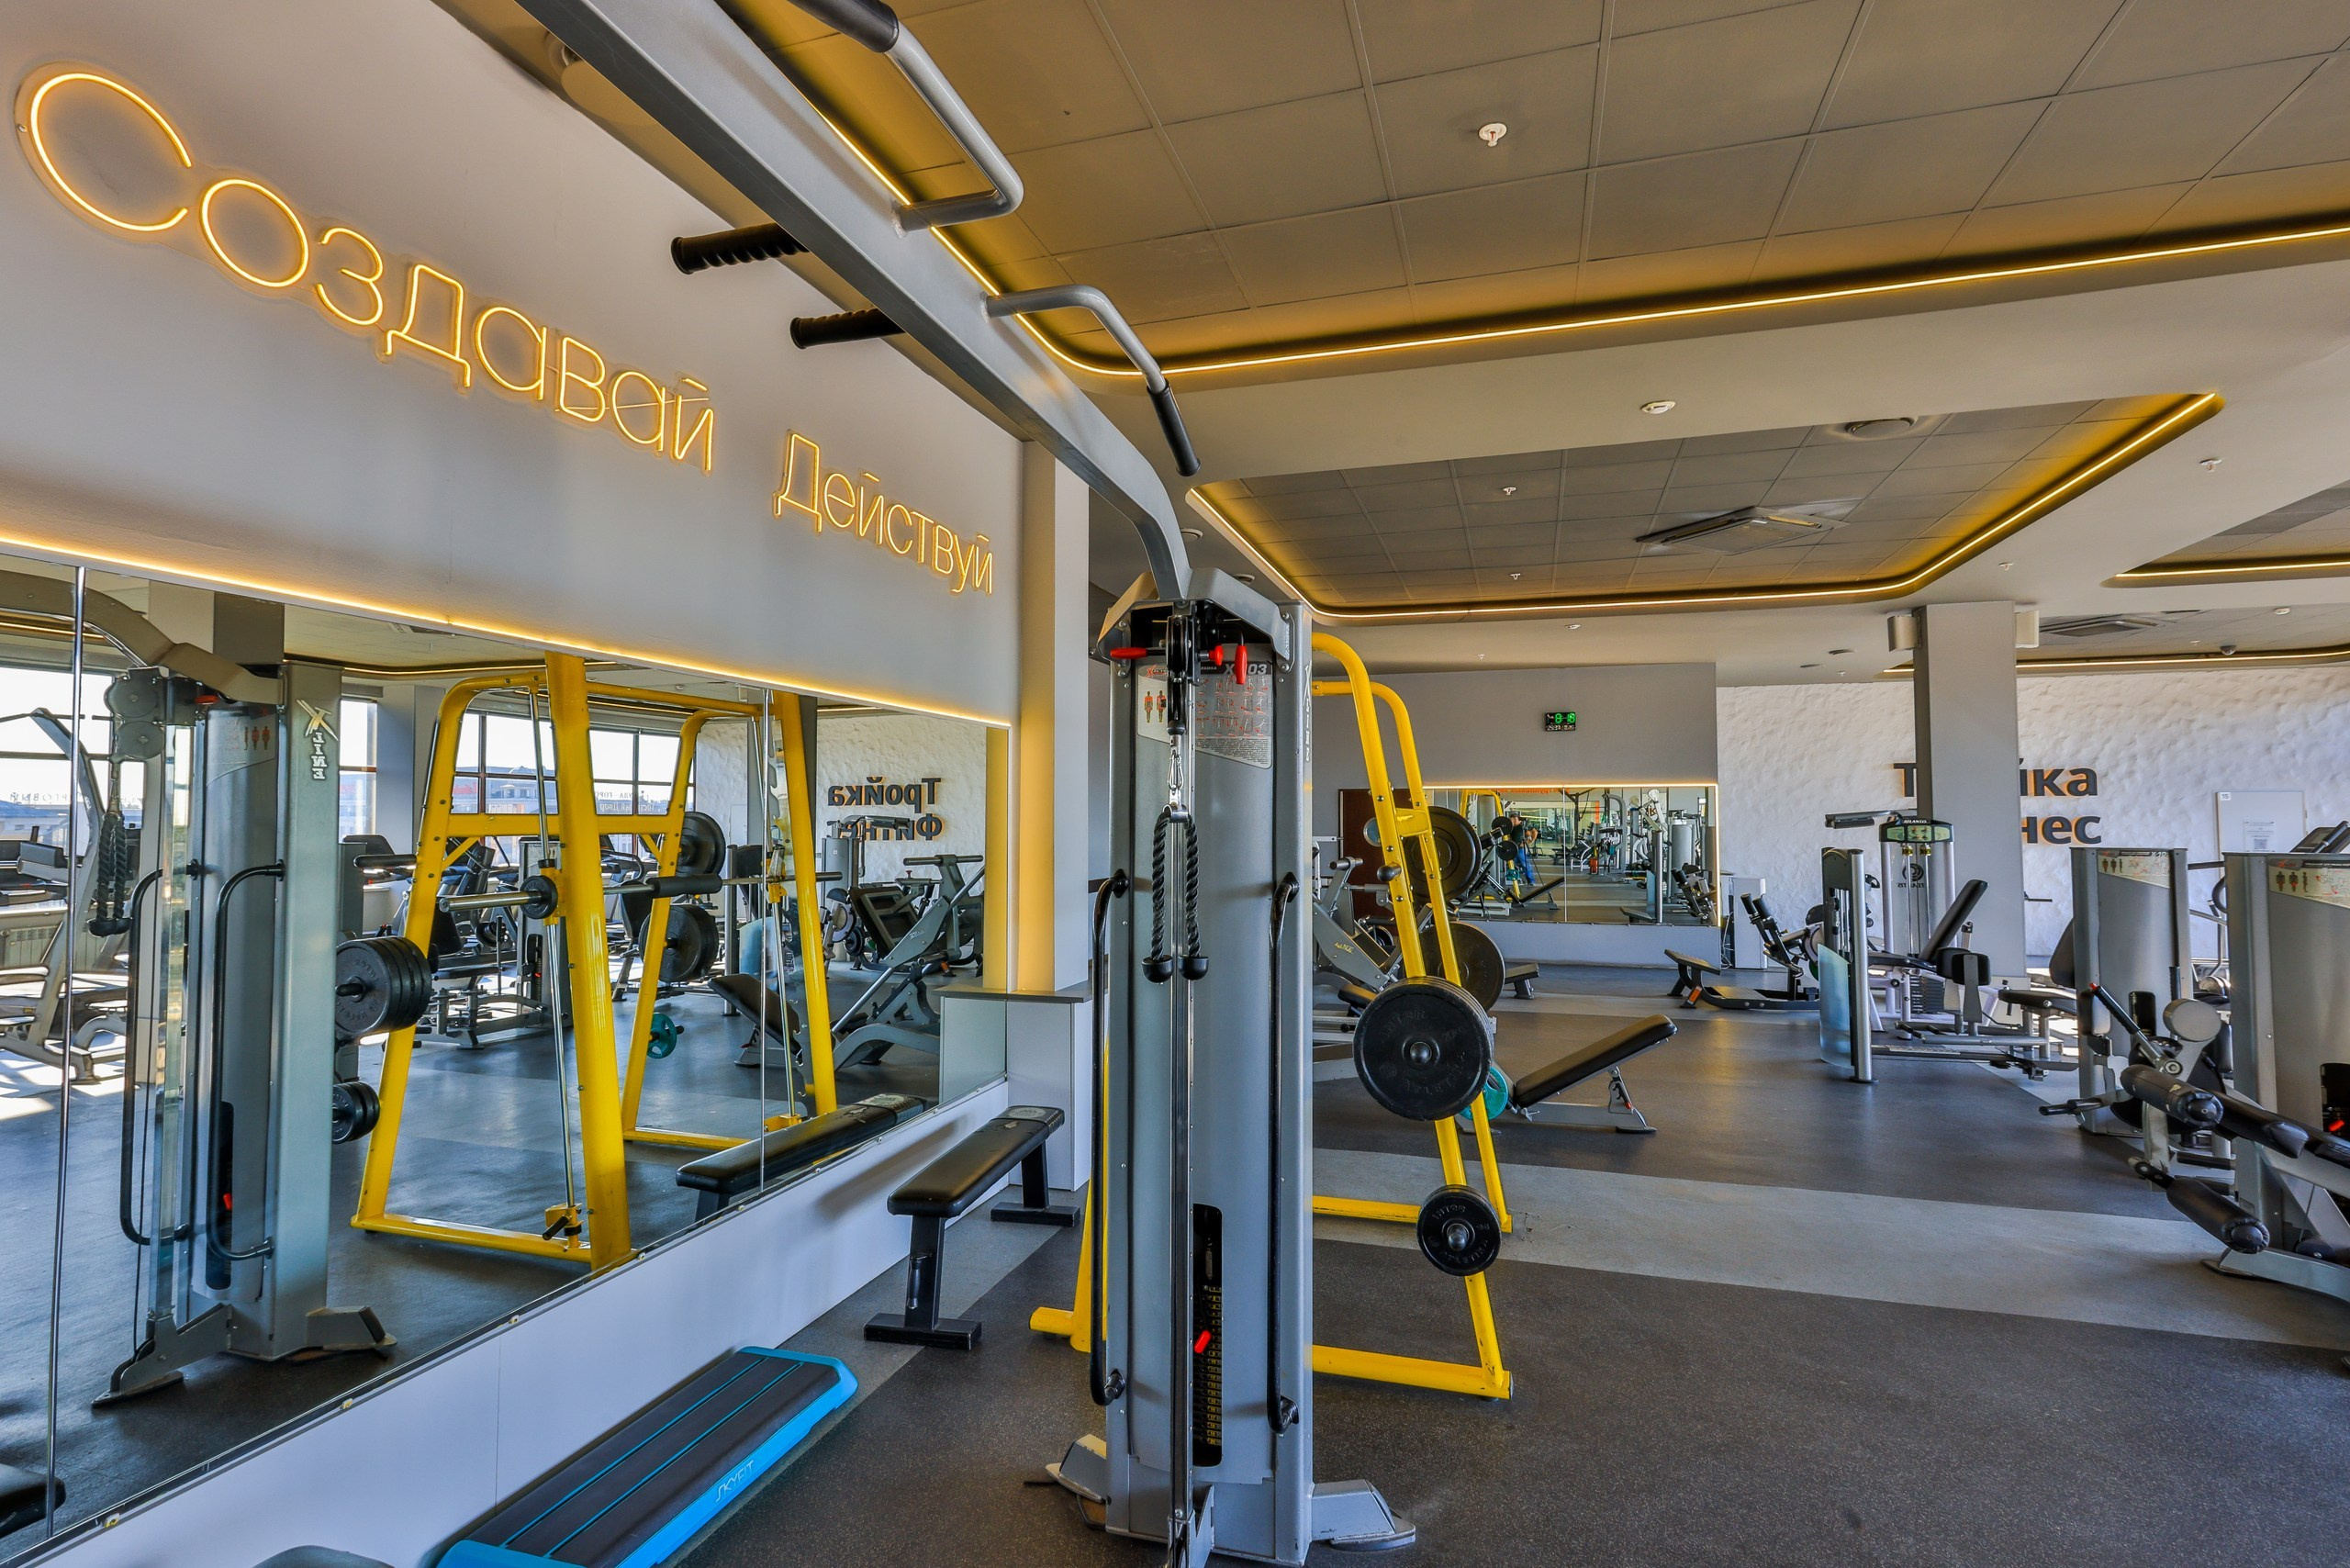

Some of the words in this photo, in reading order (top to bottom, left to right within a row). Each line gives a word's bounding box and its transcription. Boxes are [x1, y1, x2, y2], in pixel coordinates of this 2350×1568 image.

[31, 73, 713, 473] Создавай
[773, 433, 993, 595] Действуй
[1224, 664, 1267, 675] X03
